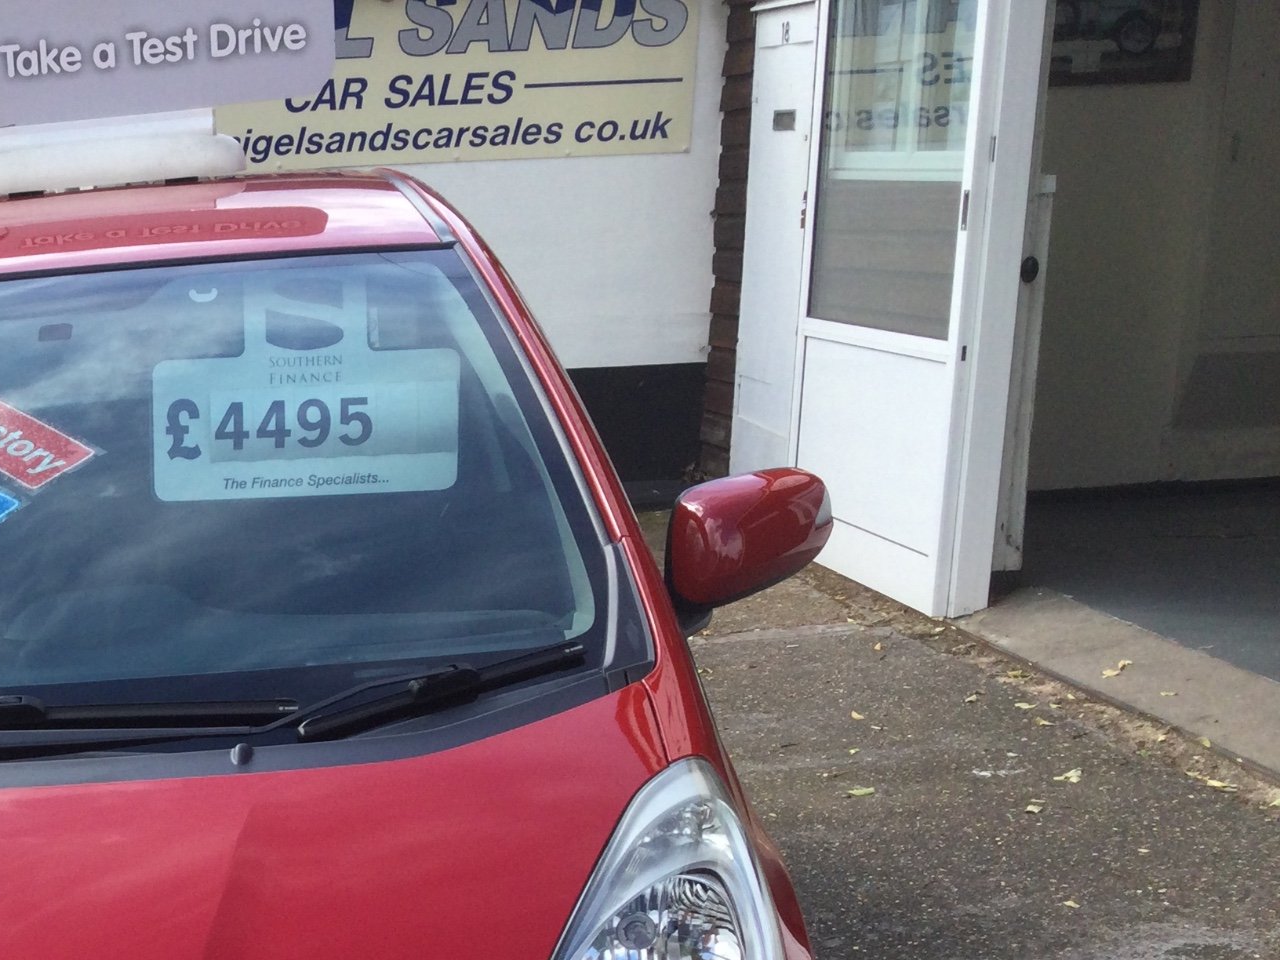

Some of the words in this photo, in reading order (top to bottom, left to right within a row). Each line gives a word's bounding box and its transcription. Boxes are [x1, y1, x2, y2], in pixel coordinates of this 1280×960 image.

[0, 39, 82, 78] Take
[93, 42, 116, 69] a
[125, 27, 198, 65] Test
[210, 18, 306, 58] Drive
[398, 0, 688, 57] SANDS
[384, 69, 516, 109] SALES
[233, 115, 564, 164] igelsandscarsales
[574, 111, 673, 143] co.uk
[269, 354, 344, 369] SOUTHERN
[269, 371, 343, 385] FINANCE
[223, 477, 247, 490] The
[251, 475, 304, 490] Finance
